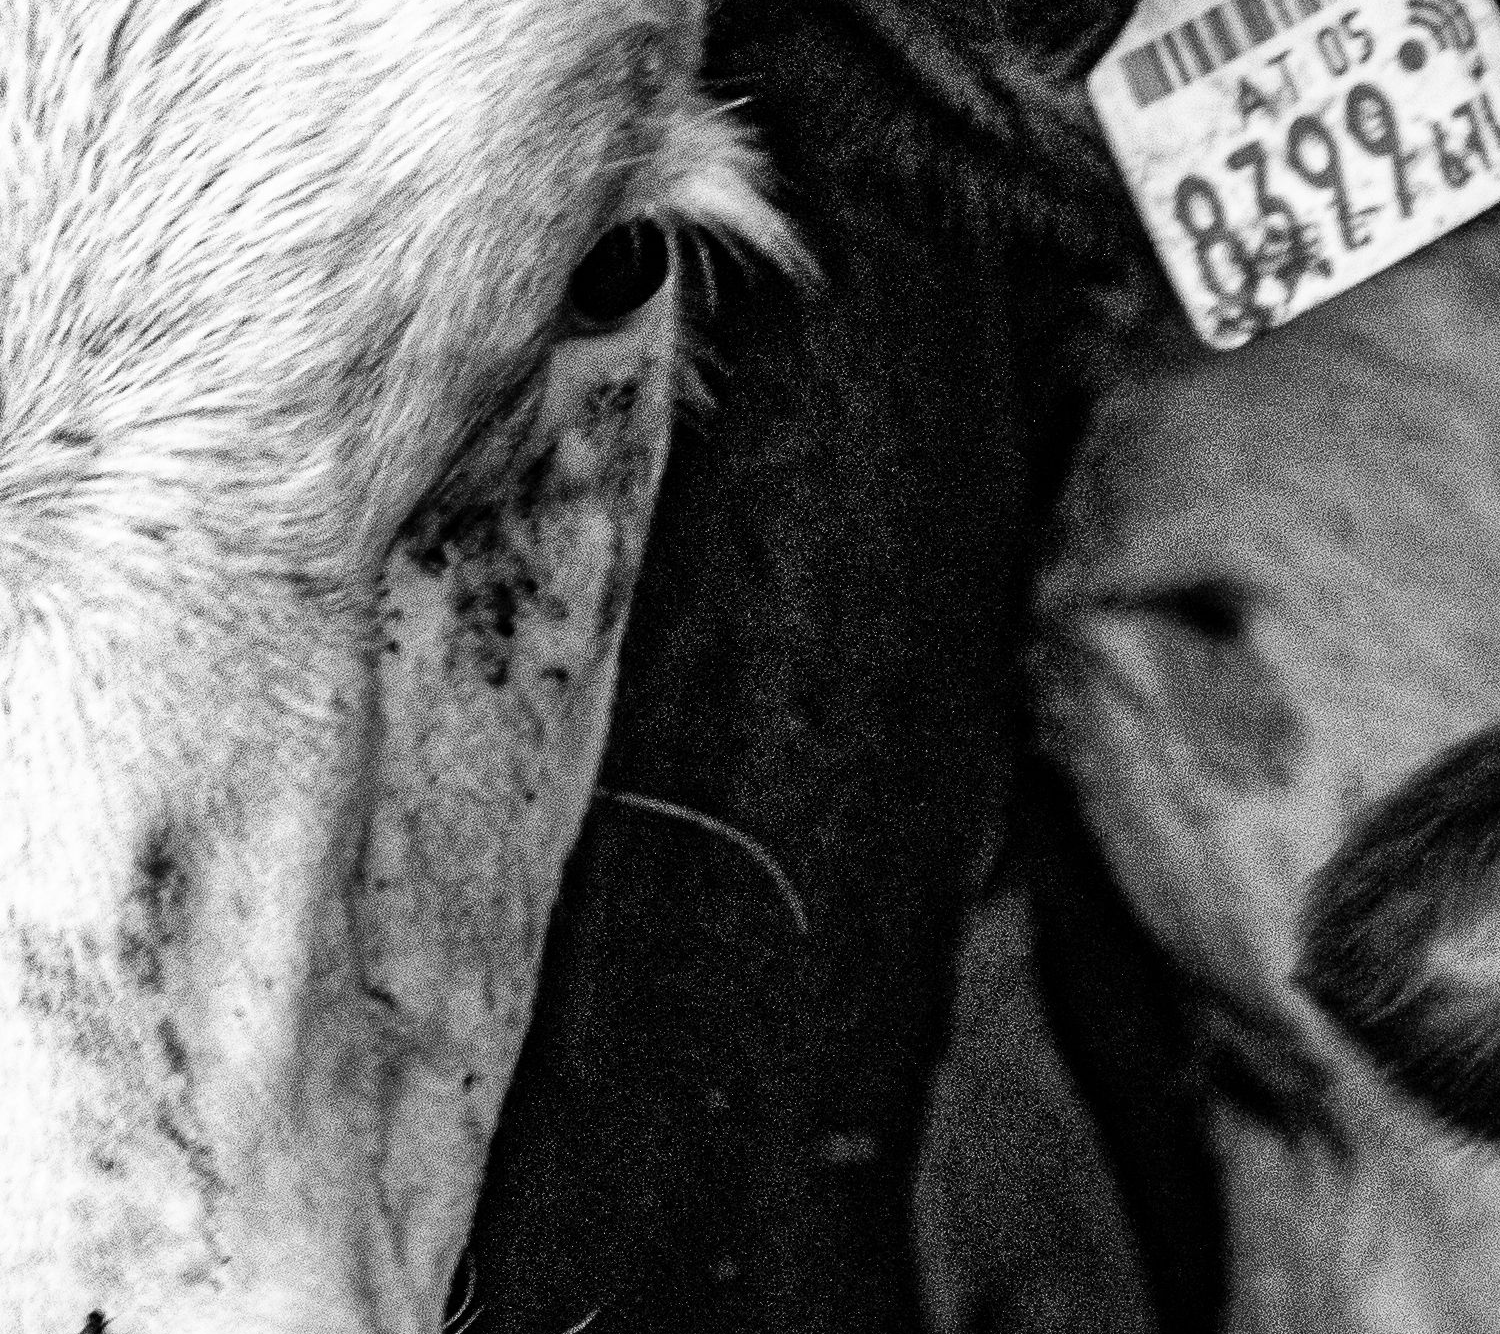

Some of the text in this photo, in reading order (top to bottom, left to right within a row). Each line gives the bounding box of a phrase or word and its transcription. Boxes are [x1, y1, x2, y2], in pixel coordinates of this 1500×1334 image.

[1236, 7, 1373, 125] AT 05
[1173, 81, 1413, 305] 8399
